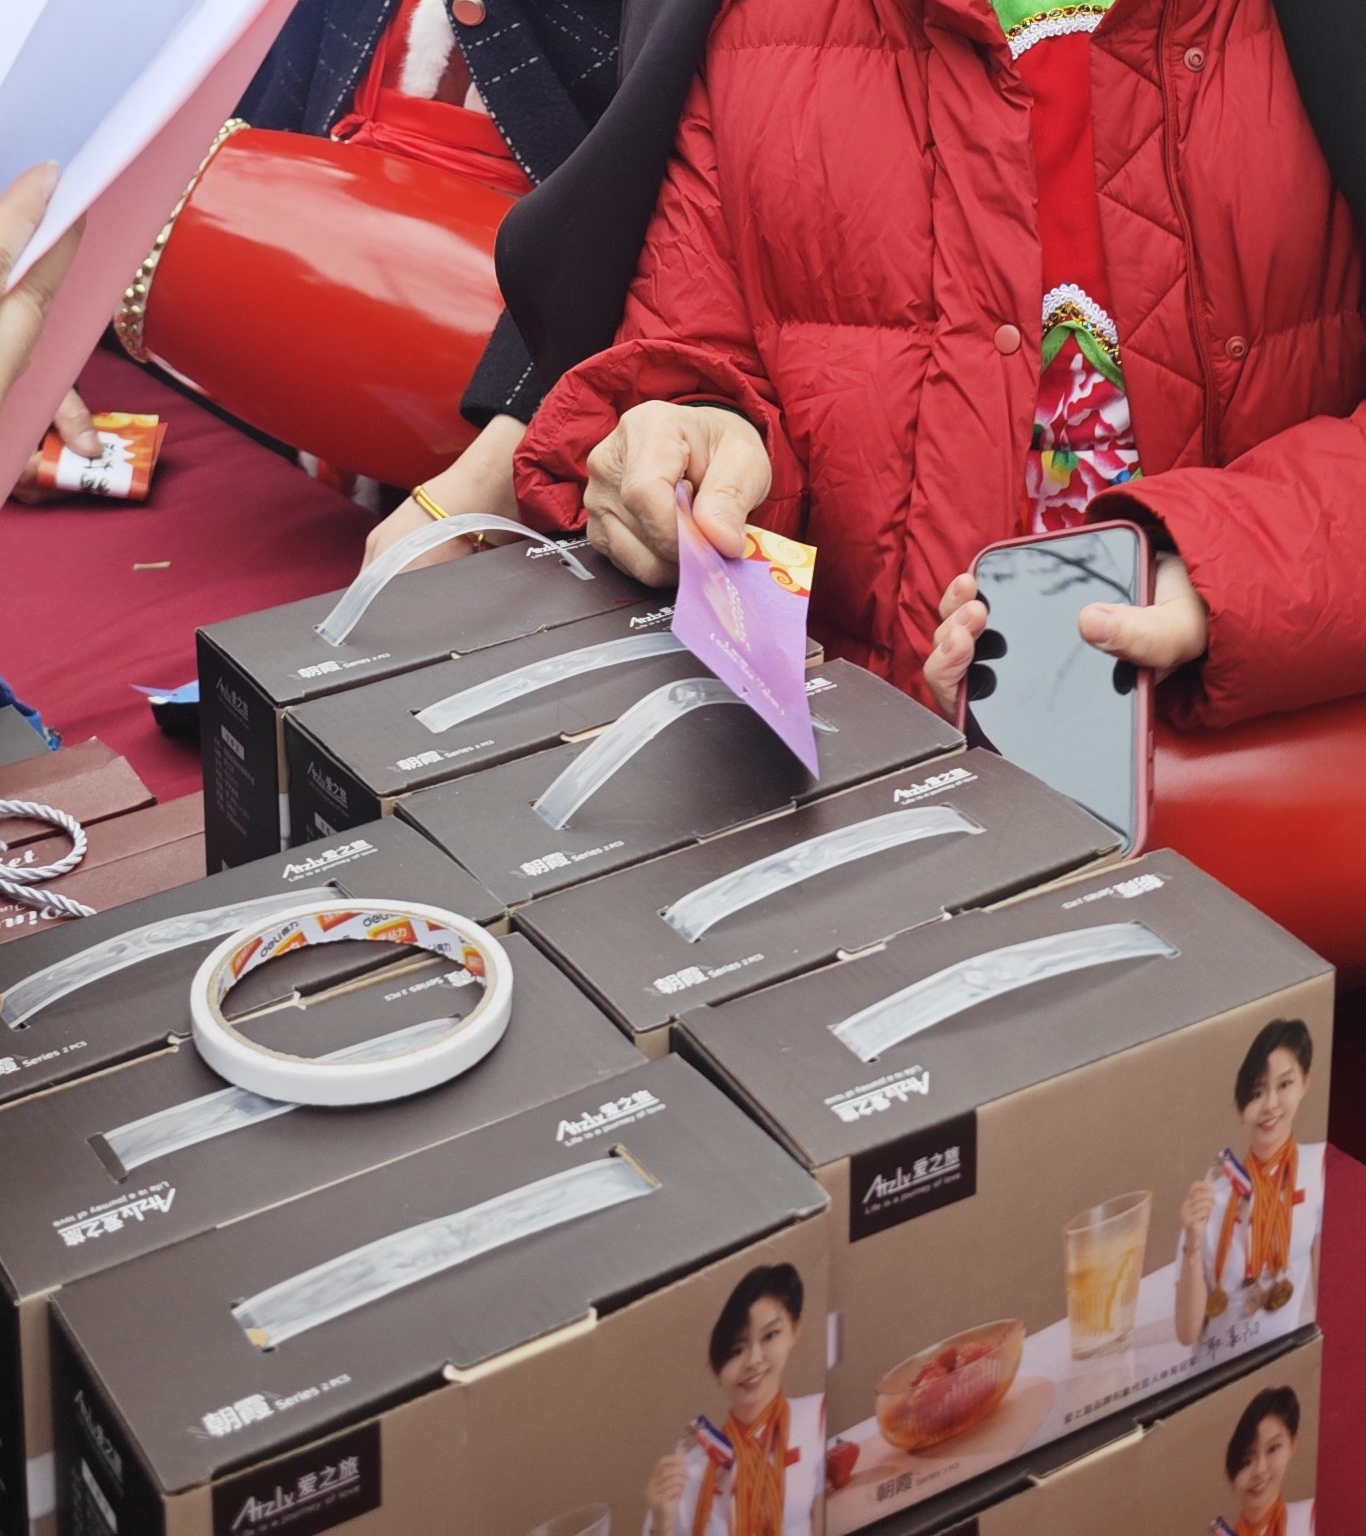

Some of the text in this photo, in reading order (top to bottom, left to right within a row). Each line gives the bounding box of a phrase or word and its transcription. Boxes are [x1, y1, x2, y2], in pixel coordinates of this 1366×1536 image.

[259, 933, 283, 958] deli
[21, 1049, 61, 1068] Series
[69, 1040, 88, 1052] PCS
[912, 1145, 961, 1179] 爱之旅
[59, 1211, 126, 1247] 爱之旅
[202, 1373, 352, 1439] 朝霞 Series 2 PCS
[297, 1455, 360, 1498] 爱之旅
[875, 1470, 914, 1504] 朝霞
